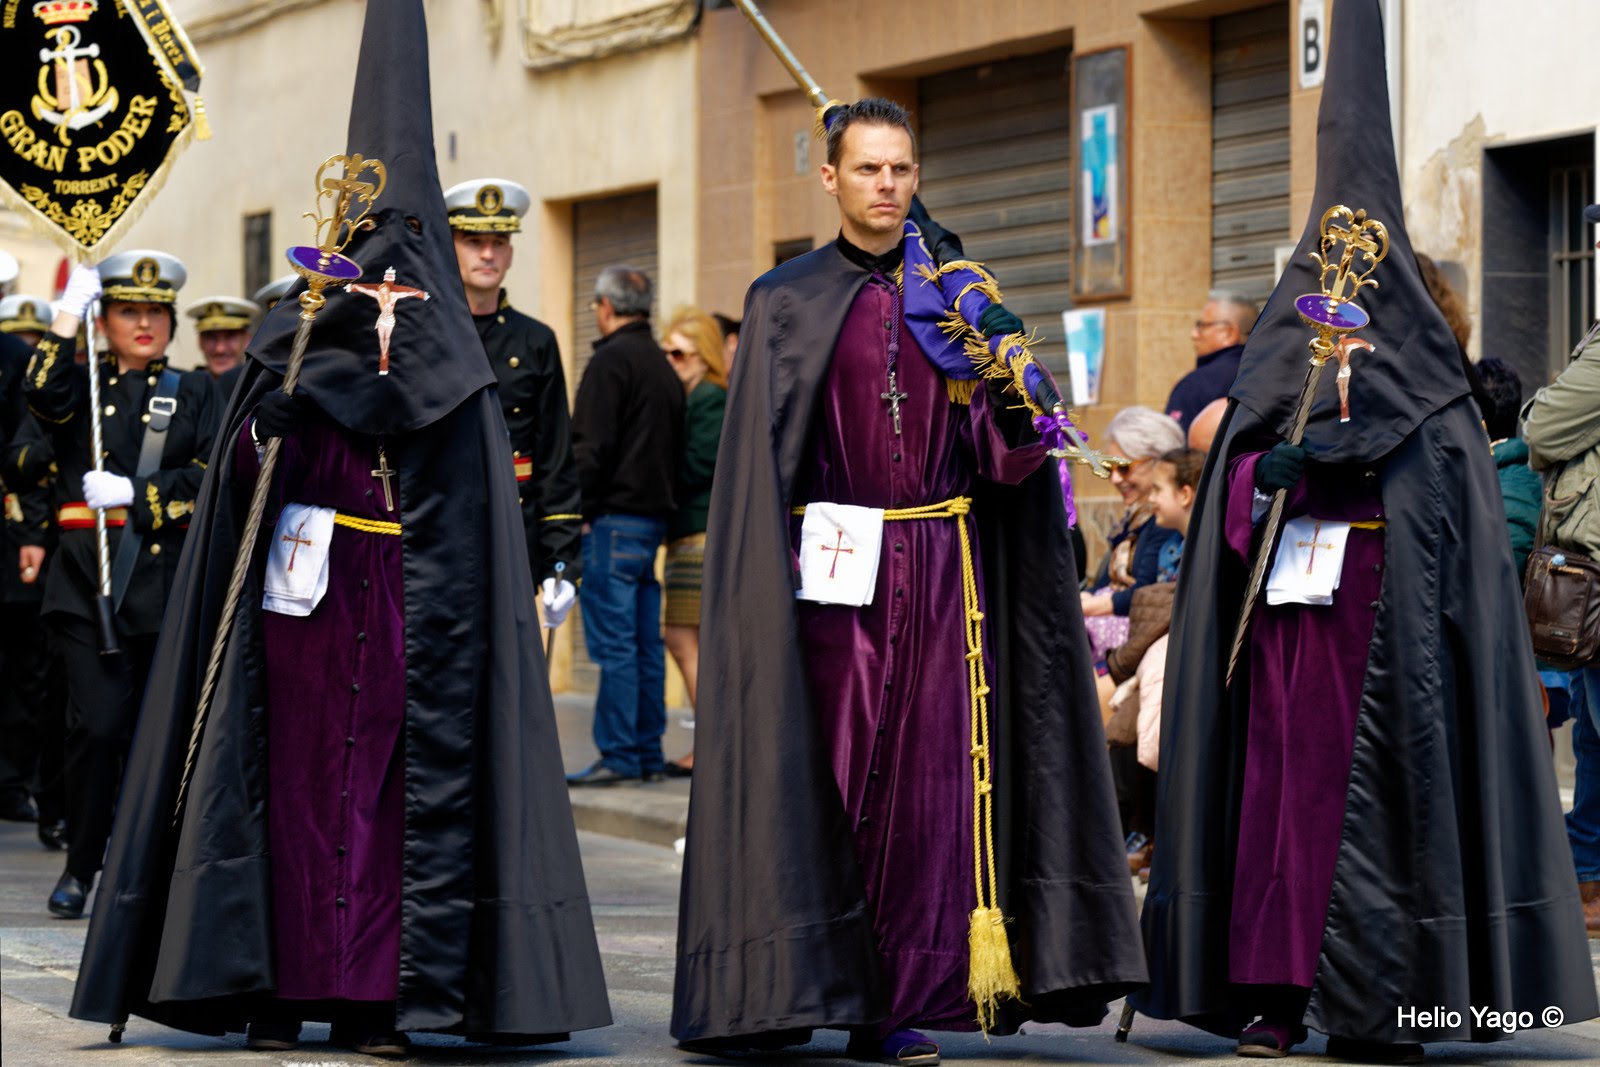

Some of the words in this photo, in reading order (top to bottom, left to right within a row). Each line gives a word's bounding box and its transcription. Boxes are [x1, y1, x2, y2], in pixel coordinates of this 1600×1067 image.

[1304, 17, 1320, 74] B
[0, 110, 68, 173] GRAN
[77, 95, 158, 173] PODER
[53, 173, 119, 195] TORRENT
